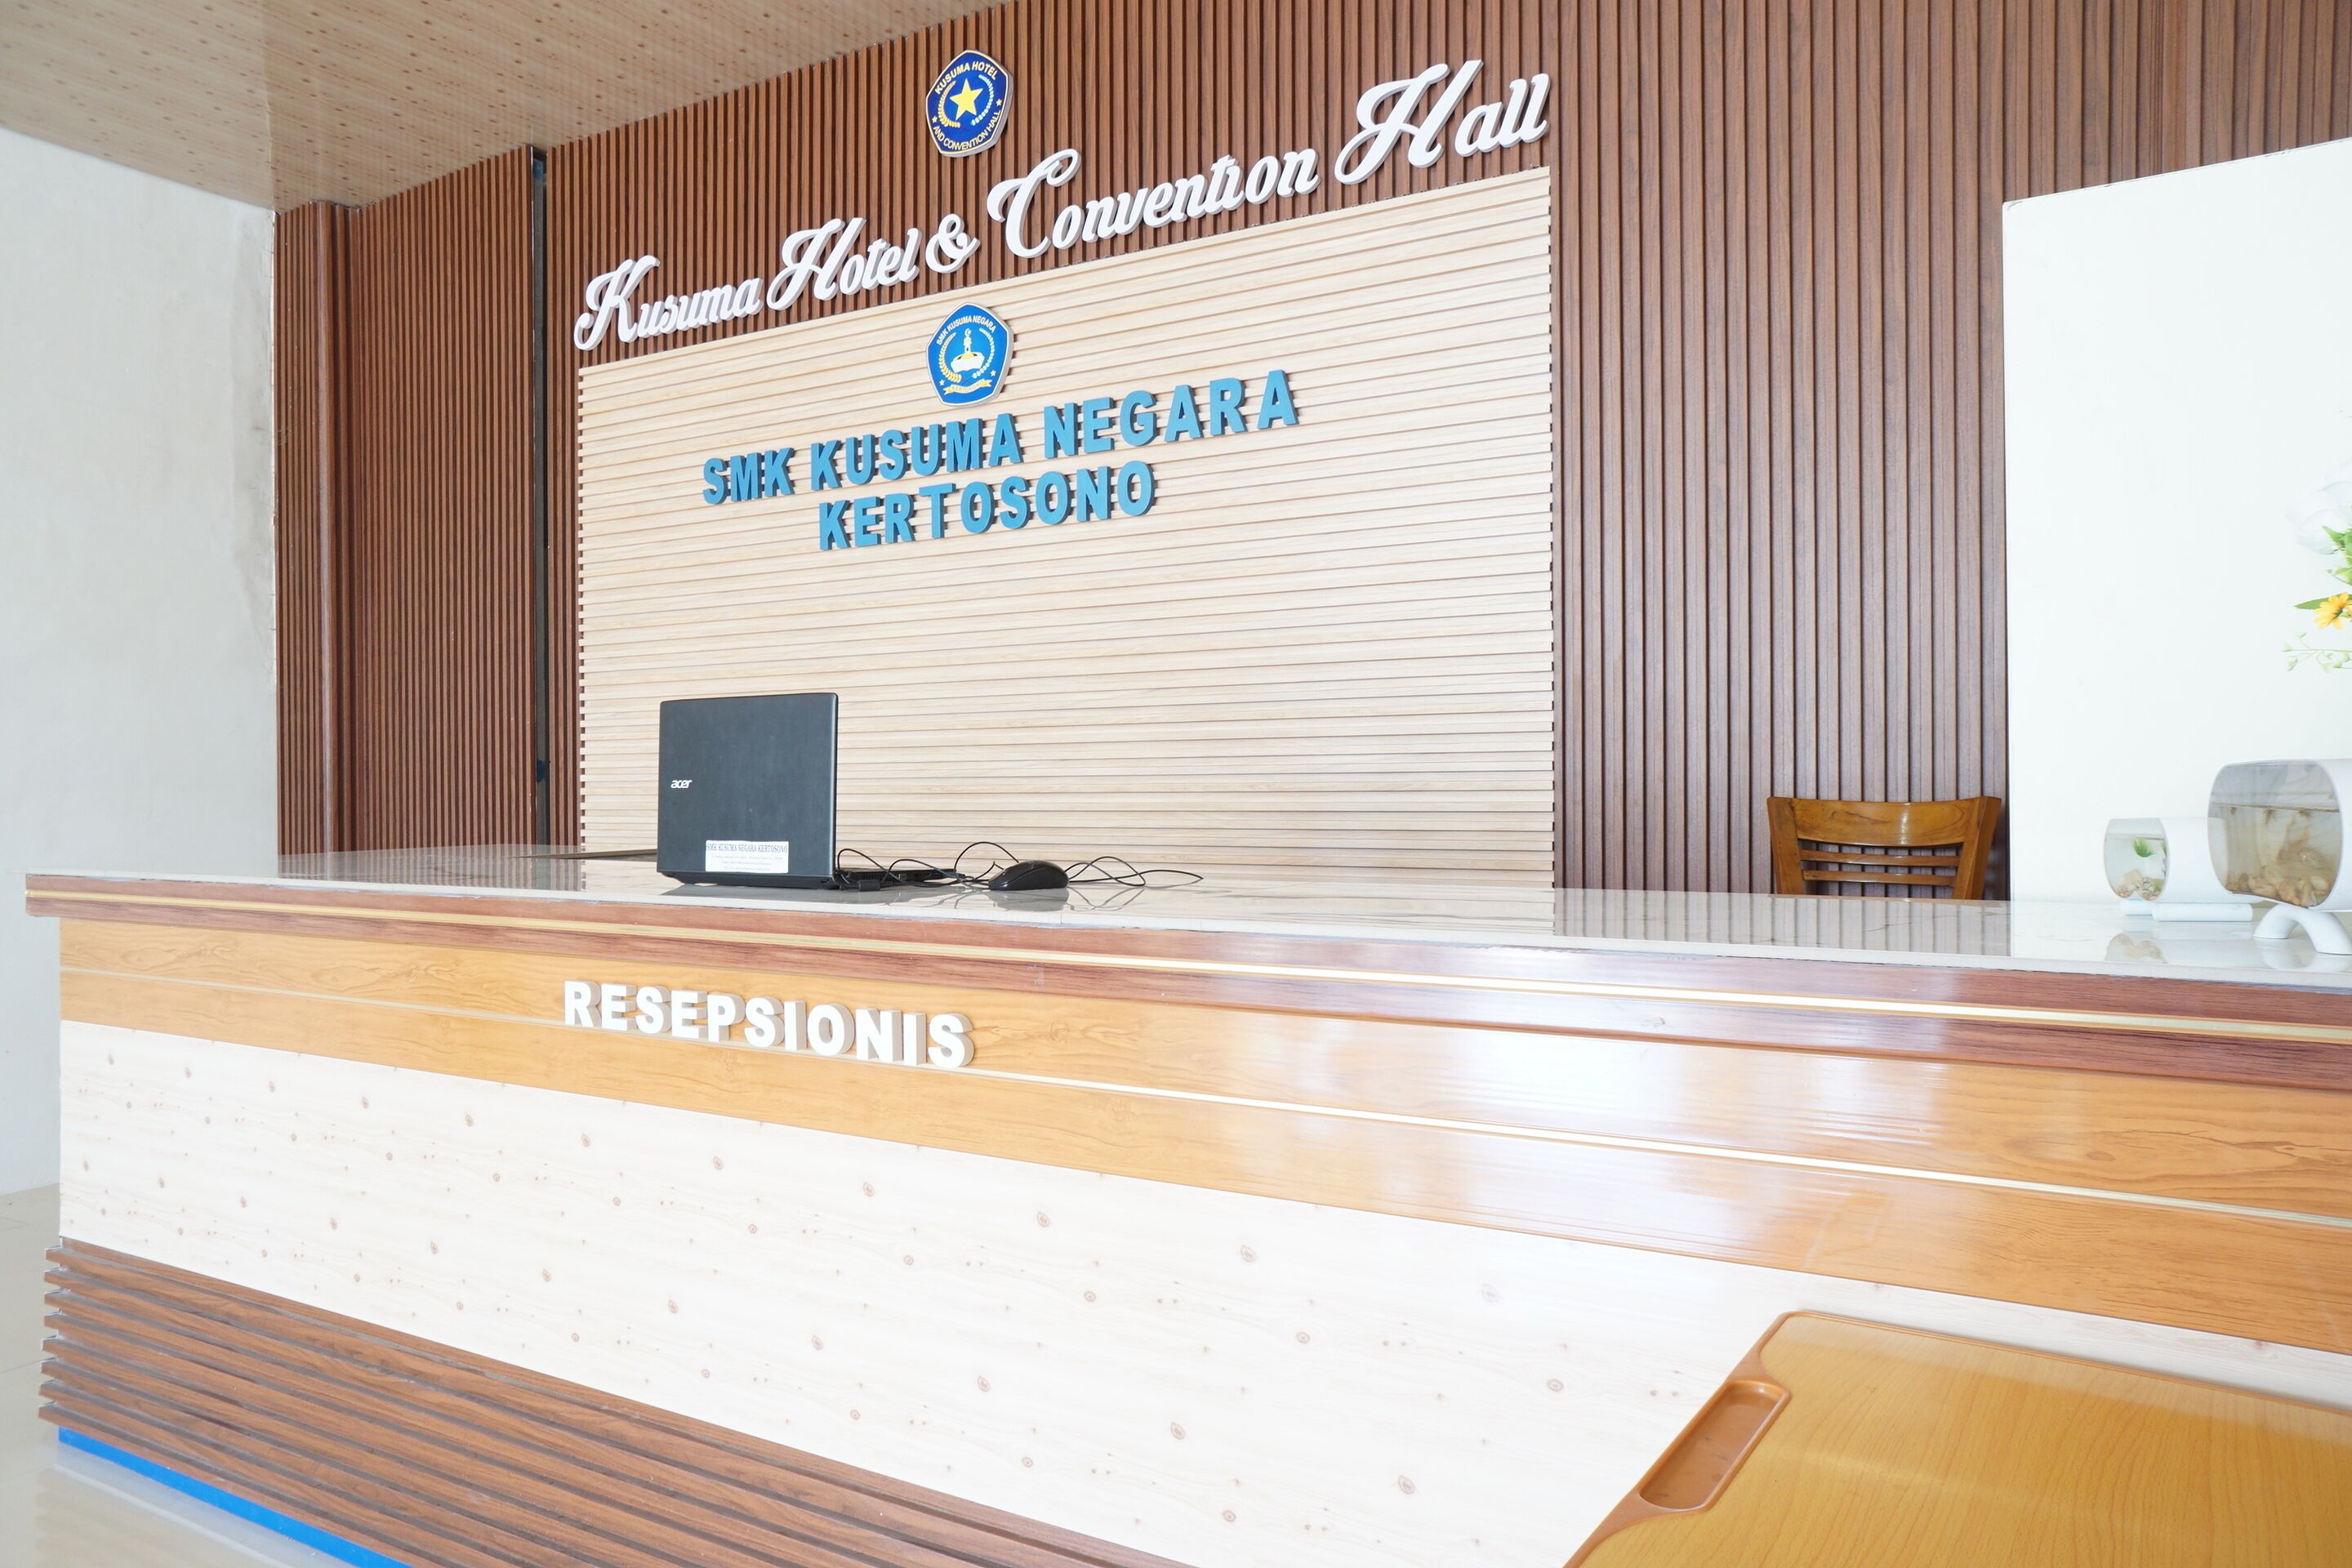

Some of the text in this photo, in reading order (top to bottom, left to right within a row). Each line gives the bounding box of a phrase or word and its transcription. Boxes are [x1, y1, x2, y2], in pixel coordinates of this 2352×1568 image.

[934, 61, 999, 95] KUSUMA HOTEL
[933, 109, 1001, 150] AND CONVENTION HALL
[573, 60, 1550, 351] Kusuma Hotel & Convention Hall
[936, 314, 996, 345] SMK KUSUMA NEGARA
[702, 370, 1298, 505] SMK KUSUMA NEGARA
[817, 461, 1156, 551] KERTOSONO
[670, 779, 693, 789] acer
[707, 842, 788, 853] SMK KUSUMA NEGARA KERTOSONO
[564, 980, 975, 1069] RESEPSIONIS
